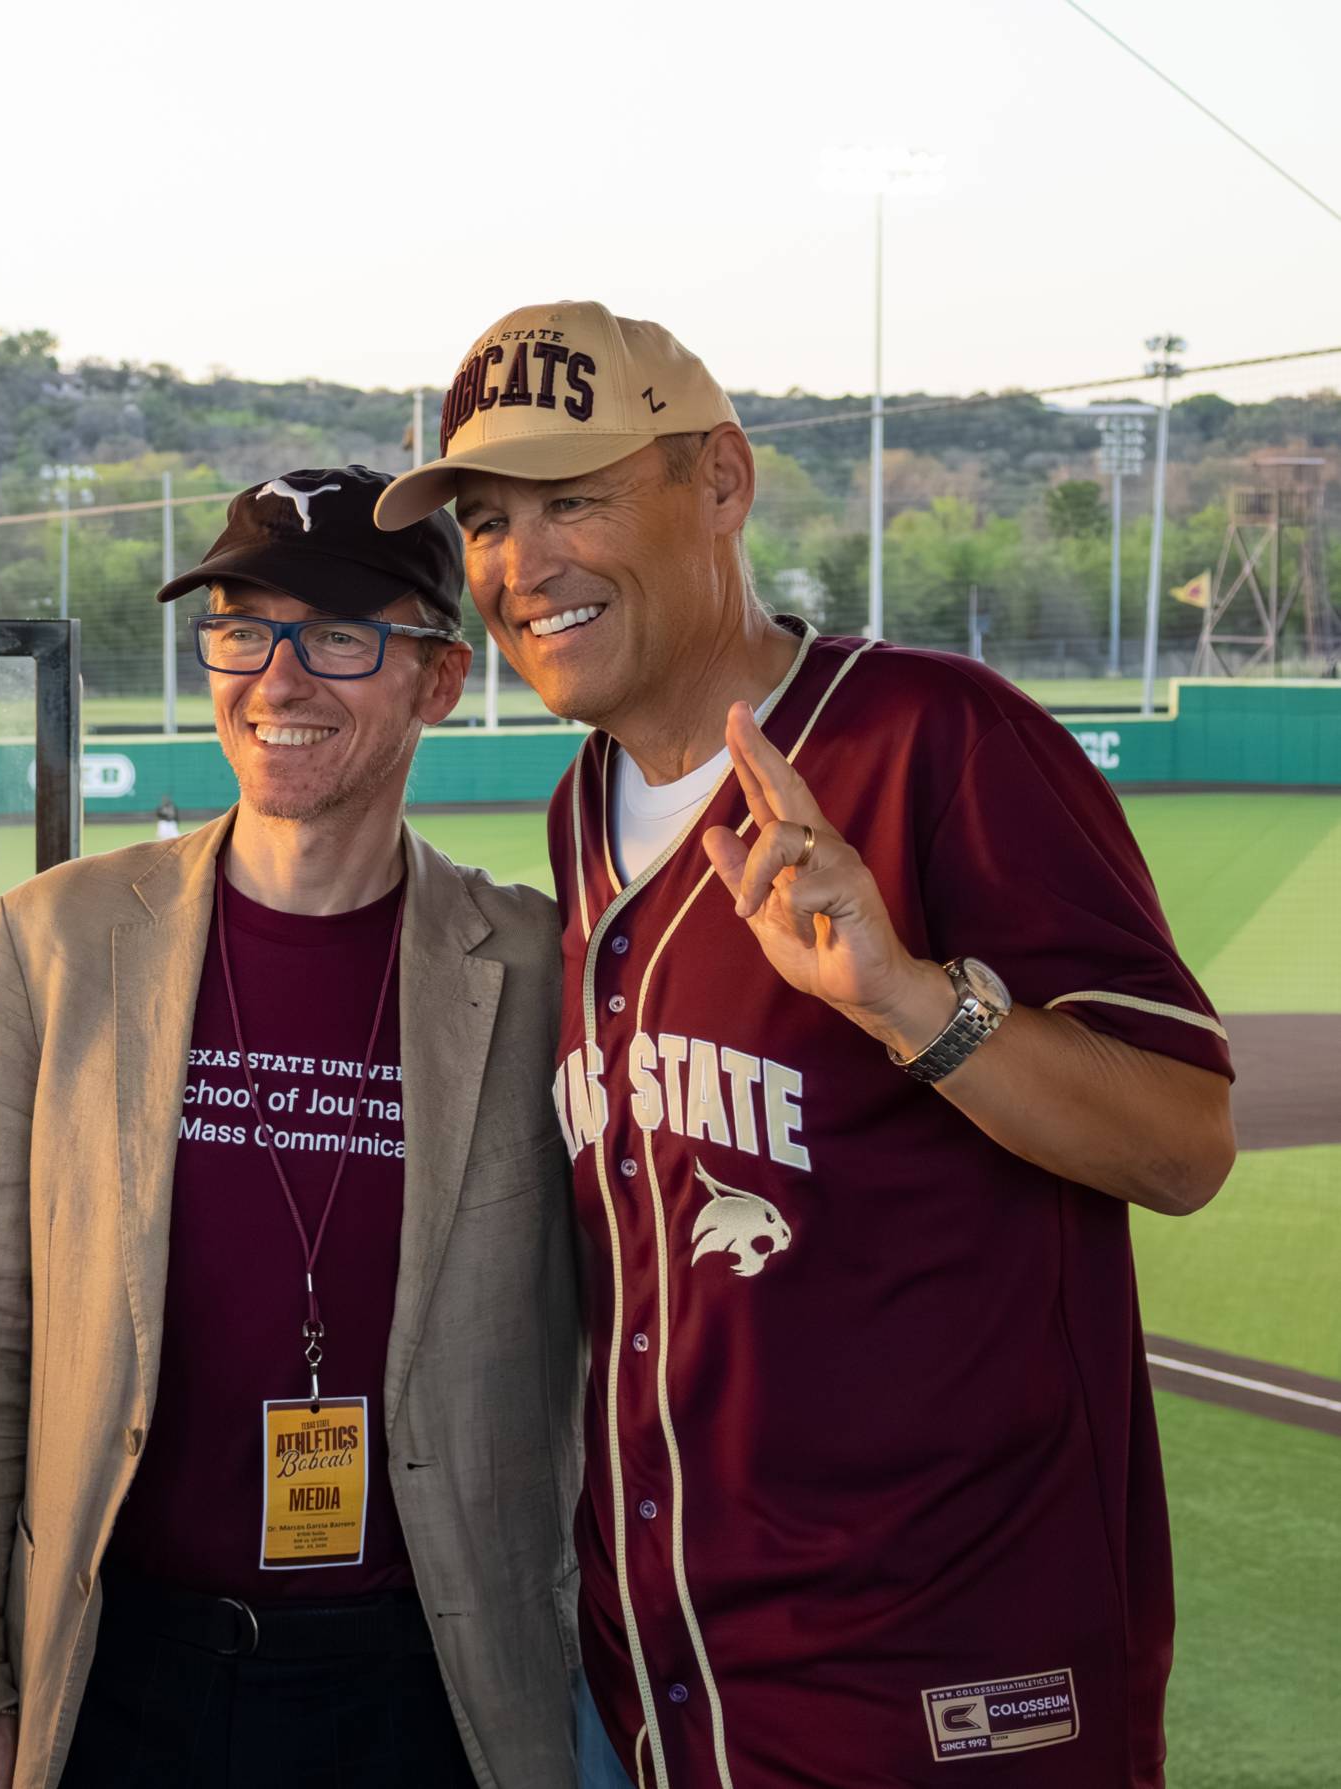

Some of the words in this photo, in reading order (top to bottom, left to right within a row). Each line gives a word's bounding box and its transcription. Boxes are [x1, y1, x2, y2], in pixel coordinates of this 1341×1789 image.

[500, 329, 565, 343] STATE
[188, 1049, 241, 1068] EXAS
[247, 1052, 315, 1075] STATE
[183, 1079, 260, 1109] choo
[268, 1088, 299, 1113] of
[306, 1089, 403, 1122] Jouna
[628, 1032, 812, 1172] STATE
[178, 1116, 247, 1145] Mass
[254, 1123, 406, 1159] Communica
[276, 1425, 358, 1458] ATHLETICS
[276, 1445, 354, 1479] Bobcats
[289, 1486, 341, 1512] MEDIA
[989, 1694, 1070, 1717] COLOSSEUM
[941, 1741, 967, 1752] SINCE
[968, 1737, 987, 1749] 1992
